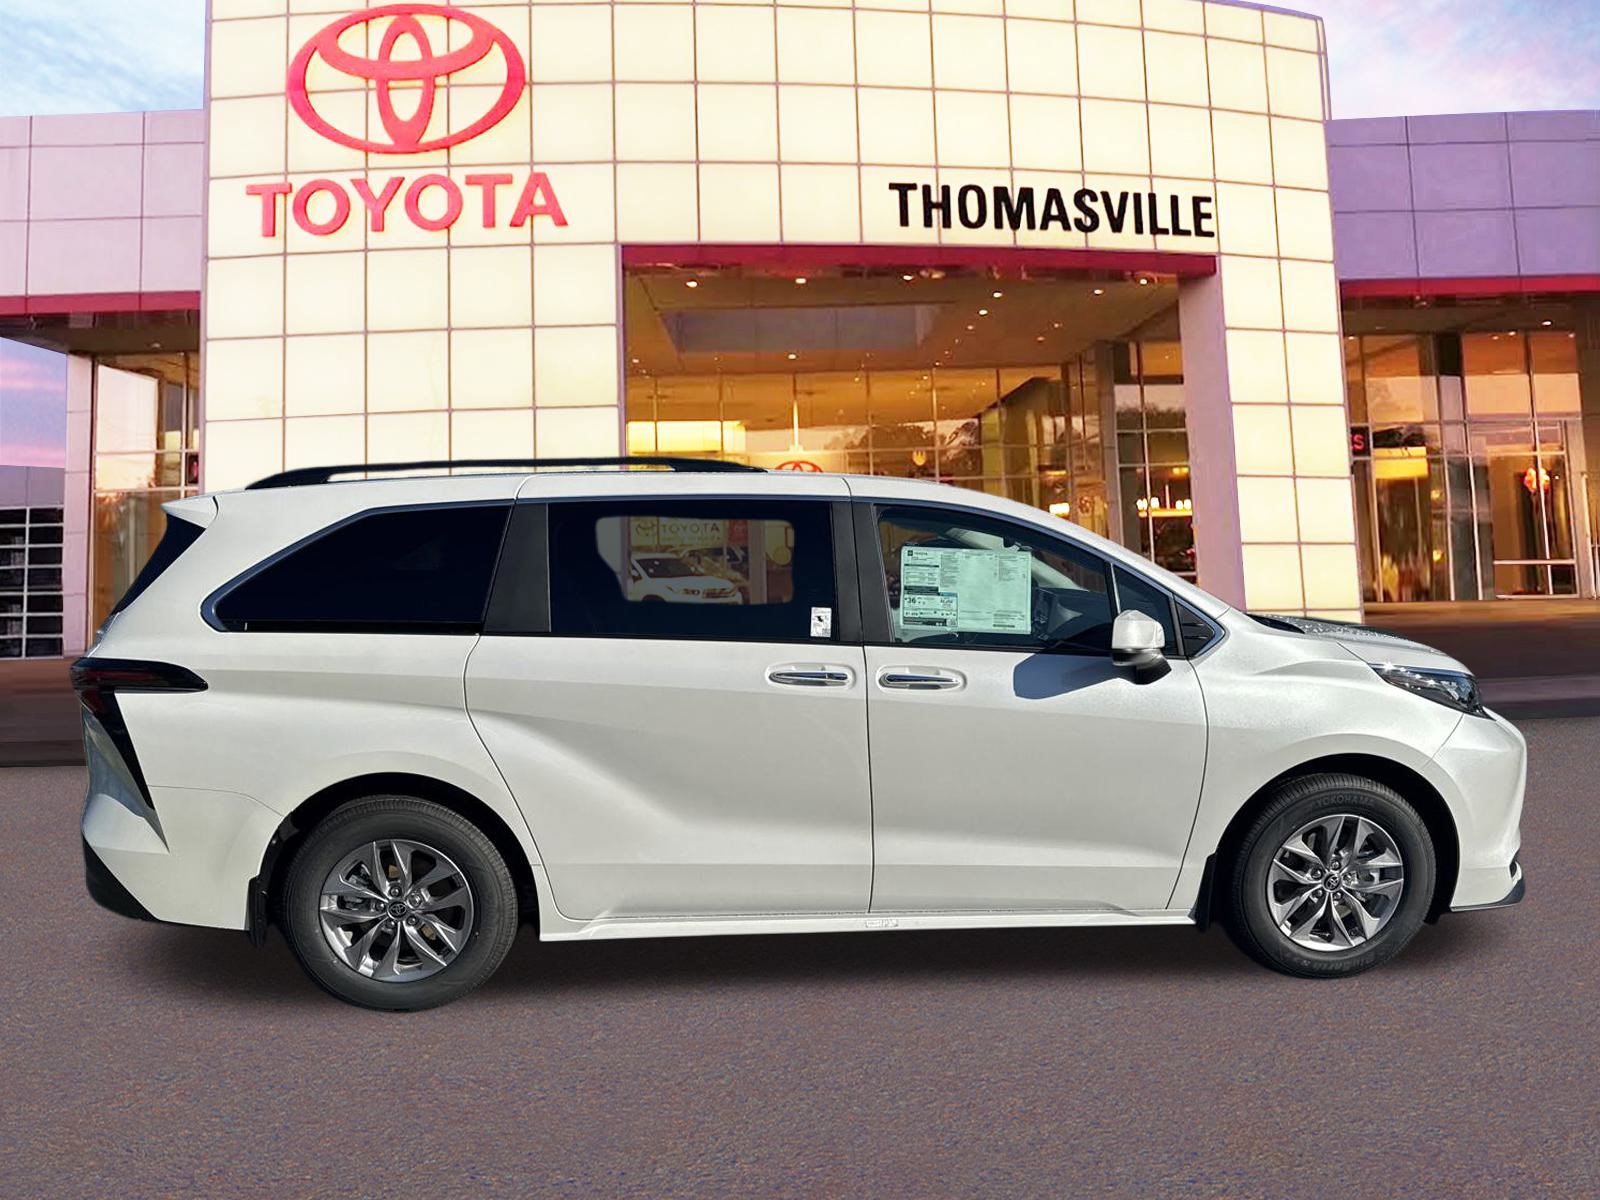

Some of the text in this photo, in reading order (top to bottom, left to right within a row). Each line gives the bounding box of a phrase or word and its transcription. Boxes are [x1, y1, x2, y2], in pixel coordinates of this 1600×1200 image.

[246, 172, 568, 237] TOYOTA
[889, 182, 1215, 238] THOMASVILLE
[661, 522, 720, 534] TOYOTA
